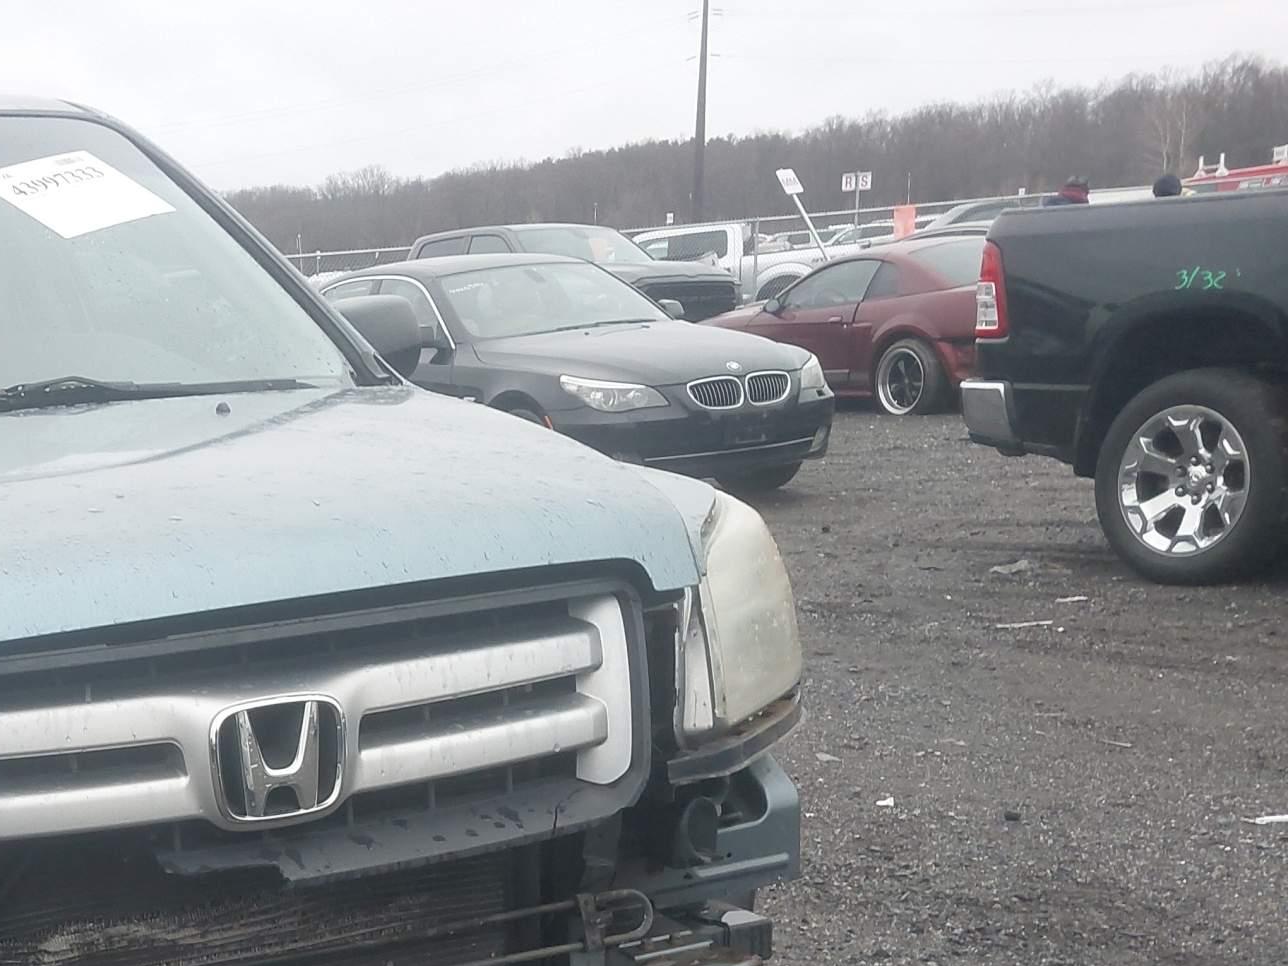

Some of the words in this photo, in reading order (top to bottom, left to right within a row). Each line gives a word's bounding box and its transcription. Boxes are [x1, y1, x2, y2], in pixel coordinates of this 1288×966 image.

[12, 166, 105, 197] 43997333
[845, 174, 853, 189] R
[860, 174, 869, 189] S
